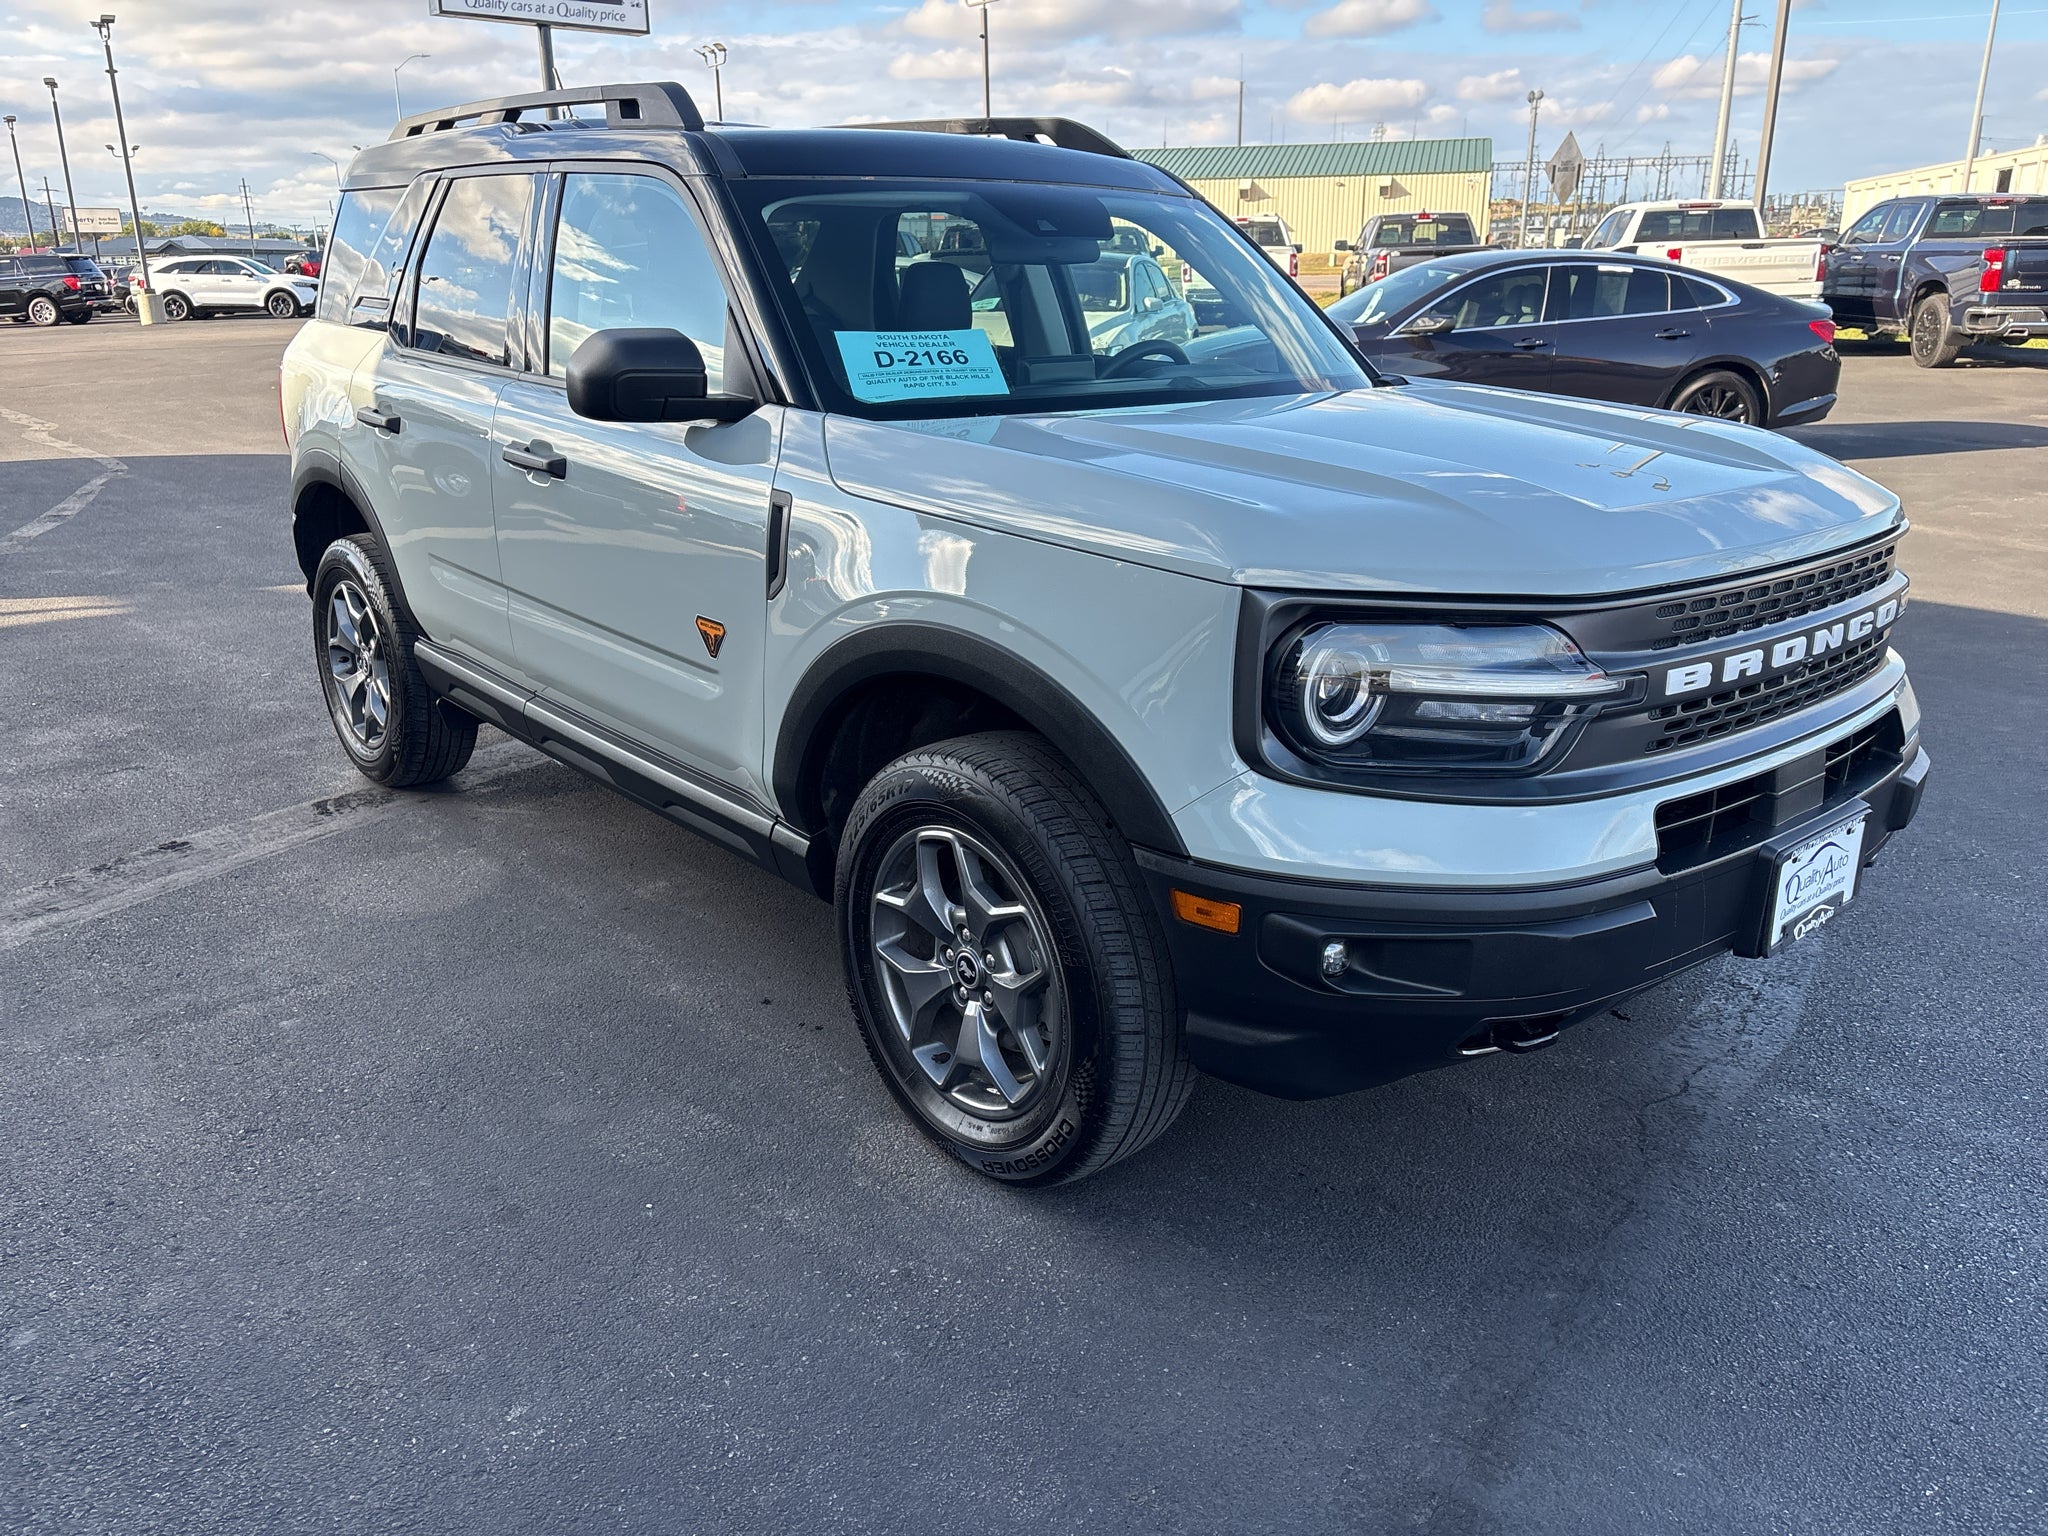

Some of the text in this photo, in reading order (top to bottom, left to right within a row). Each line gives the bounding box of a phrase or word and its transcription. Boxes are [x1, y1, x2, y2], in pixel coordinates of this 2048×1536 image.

[465, 0, 508, 12] Quality
[511, 2, 533, 13] cars
[534, 3, 546, 14] at
[556, 2, 598, 21] Quality
[600, 10, 626, 22] price
[1690, 255, 1808, 265] CHEVROLET
[873, 349, 969, 368] D-2166
[866, 378, 897, 386] QUALITY
[1665, 599, 1898, 696] BRONCO
[847, 778, 914, 851] 225/65R17
[1780, 904, 1797, 920] Quality
[1796, 898, 1807, 908] cars
[1815, 883, 1833, 897] Quality
[1832, 876, 1845, 889] price
[980, 1118, 1076, 1175] CROSSOVER
